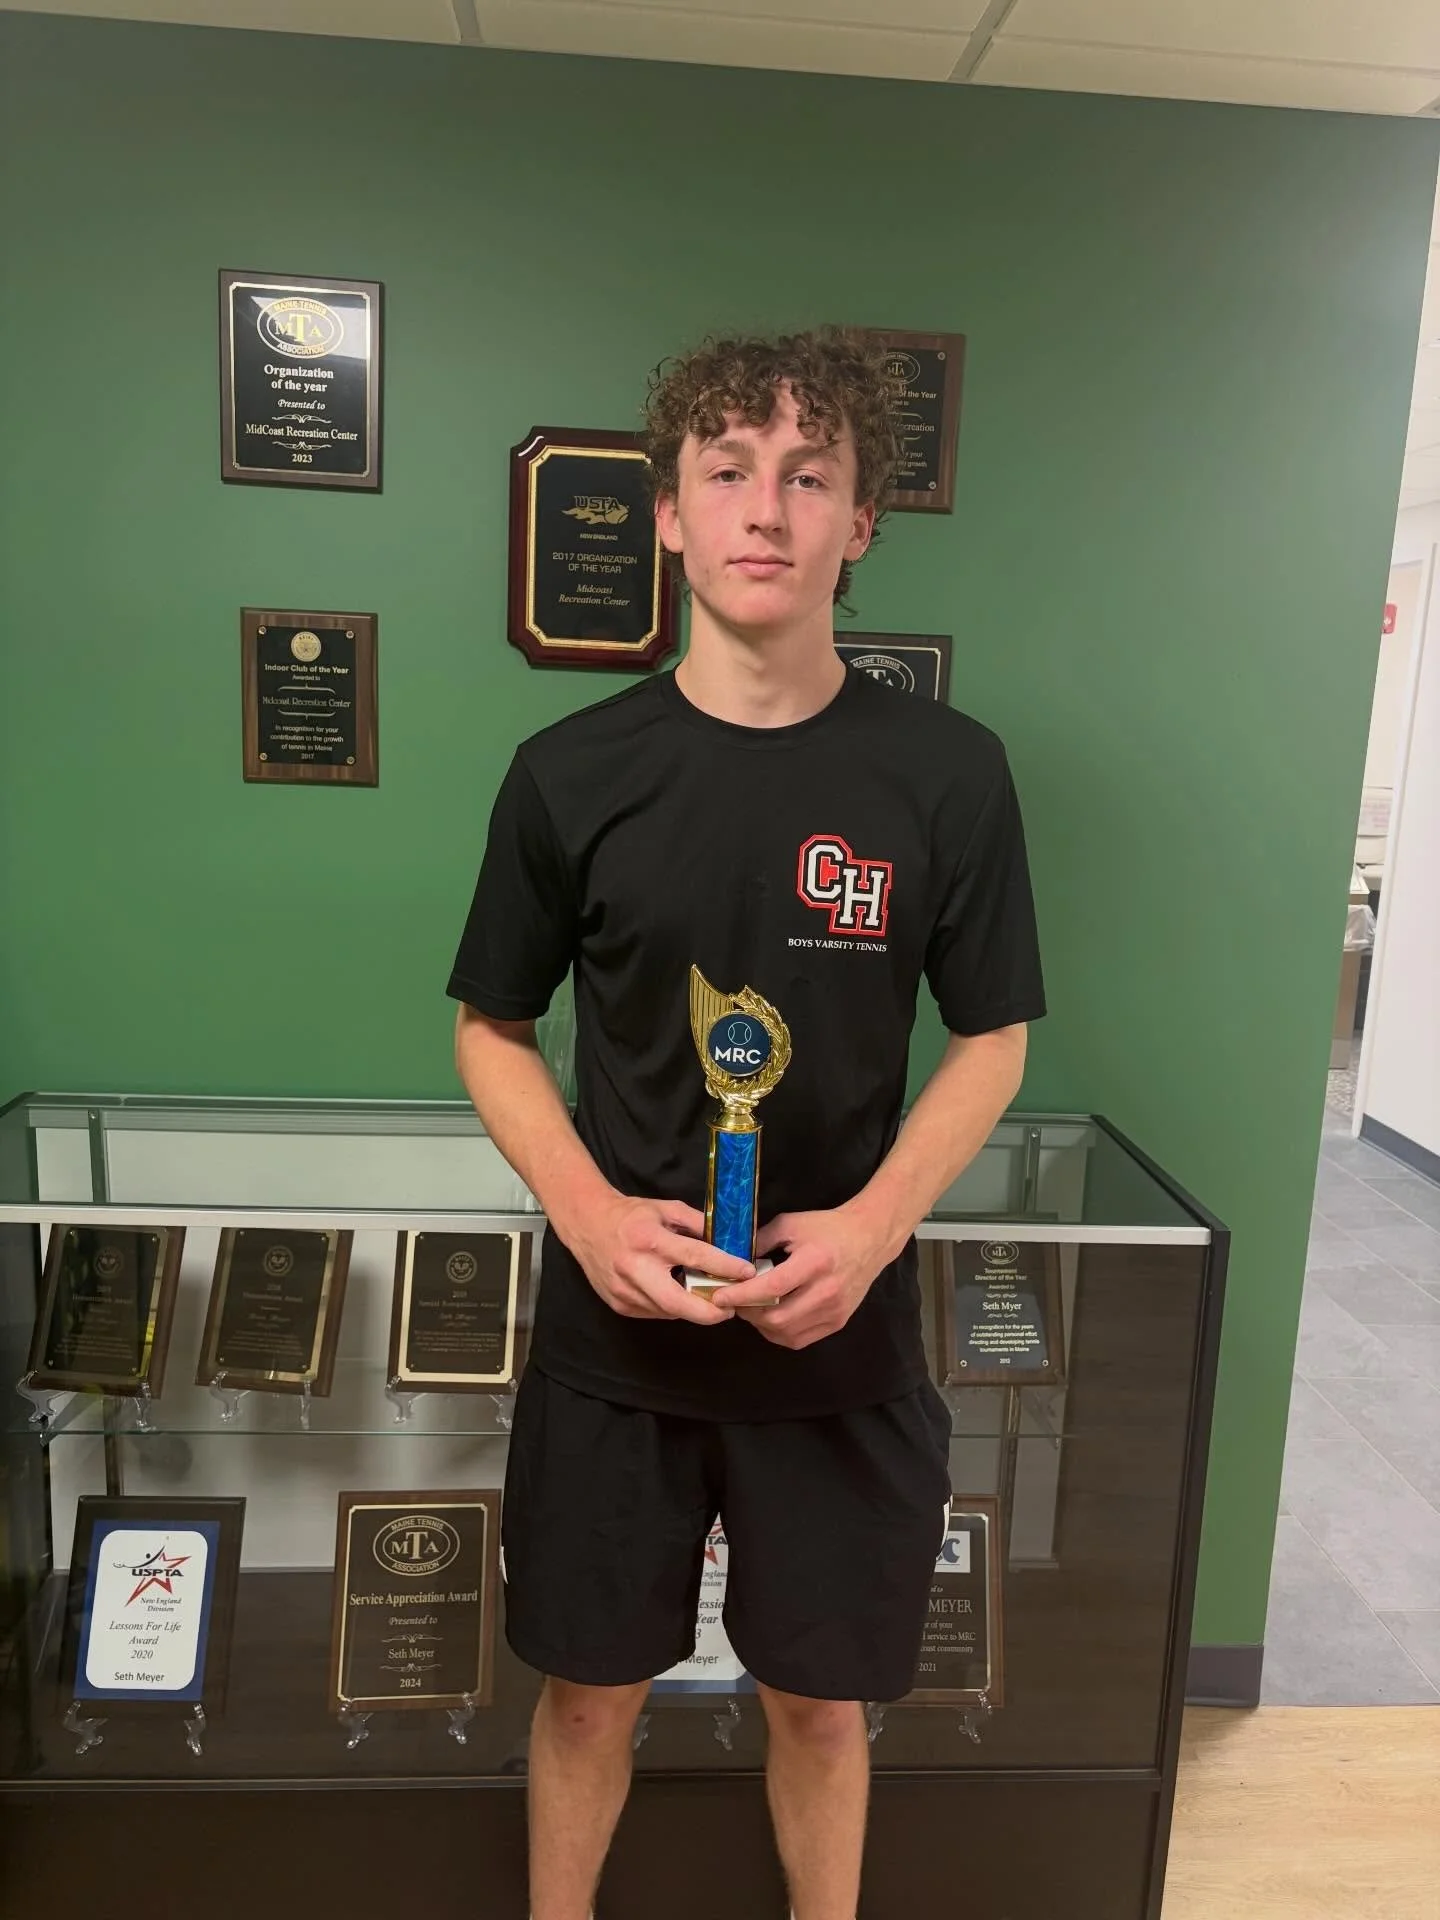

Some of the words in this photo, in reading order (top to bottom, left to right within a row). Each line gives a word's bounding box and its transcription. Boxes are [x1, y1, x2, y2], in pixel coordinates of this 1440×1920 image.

[274, 300, 298, 313] MAINE
[300, 300, 327, 315] TENNIS
[274, 313, 323, 343] MTA
[277, 343, 325, 355] ASSOCIATION
[264, 364, 334, 379] Organization
[271, 380, 282, 390] of
[285, 380, 300, 391] the
[303, 382, 327, 393] year
[921, 391, 937, 399] Year
[278, 399, 316, 410] Presented
[317, 402, 325, 410] to
[245, 423, 284, 436] MidCoast
[286, 426, 329, 439] Recreation
[331, 428, 358, 441] Center
[903, 422, 935, 432] creation
[292, 453, 313, 463] 2023
[574, 495, 620, 511] USTA
[552, 552, 574, 561] 2017
[577, 553, 637, 565] ORGANIZATION
[568, 563, 580, 571] OF
[582, 563, 598, 572] THE
[600, 564, 622, 574] YEAR
[576, 584, 613, 594] Midcoast
[558, 594, 601, 605] Recreation
[603, 596, 630, 607] Center
[264, 663, 289, 672] Indoor
[290, 664, 308, 672] Club
[332, 666, 349, 674] Year
[853, 658, 874, 668] MAINE
[877, 658, 901, 669] TENNIS
[329, 698, 351, 708] Center
[282, 725, 315, 733] recognition
[323, 736, 344, 744] growth
[803, 840, 887, 930] CH
[788, 938, 813, 948] BOYS
[814, 939, 854, 950] VARSITY
[856, 942, 888, 952] TENNIS
[714, 1046, 762, 1064] MRC
[982, 1301, 1000, 1311] Seth
[1001, 1301, 1022, 1312] Myer
[391, 1518, 415, 1531] MAINE
[417, 1518, 444, 1530] TENNIS
[391, 1531, 439, 1560] MTA
[131, 1568, 184, 1577] USPTA
[392, 1561, 440, 1573] ASSOCIATION
[704, 1570, 728, 1579] nglan
[141, 1597, 155, 1605] New
[156, 1597, 182, 1606] England
[350, 1593, 384, 1606] Service
[386, 1591, 445, 1607] Appreciation
[447, 1590, 478, 1602] Award
[147, 1605, 175, 1613] Division
[928, 1599, 973, 1613] MEYER
[389, 1615, 429, 1626] Presented
[109, 1620, 143, 1631] Lessons
[145, 1621, 162, 1631] For
[164, 1621, 182, 1633] Life
[128, 1636, 159, 1646] Award
[927, 1632, 949, 1641] service
[957, 1631, 976, 1641] MRC
[130, 1650, 153, 1659] 2020
[388, 1648, 408, 1659] Seth
[408, 1649, 435, 1660] Meyer
[685, 1655, 719, 1666] Meyer
[918, 1662, 937, 1672] 2021
[114, 1671, 134, 1681] Seth
[136, 1673, 165, 1683] Meyer
[400, 1678, 422, 1688] 2024
